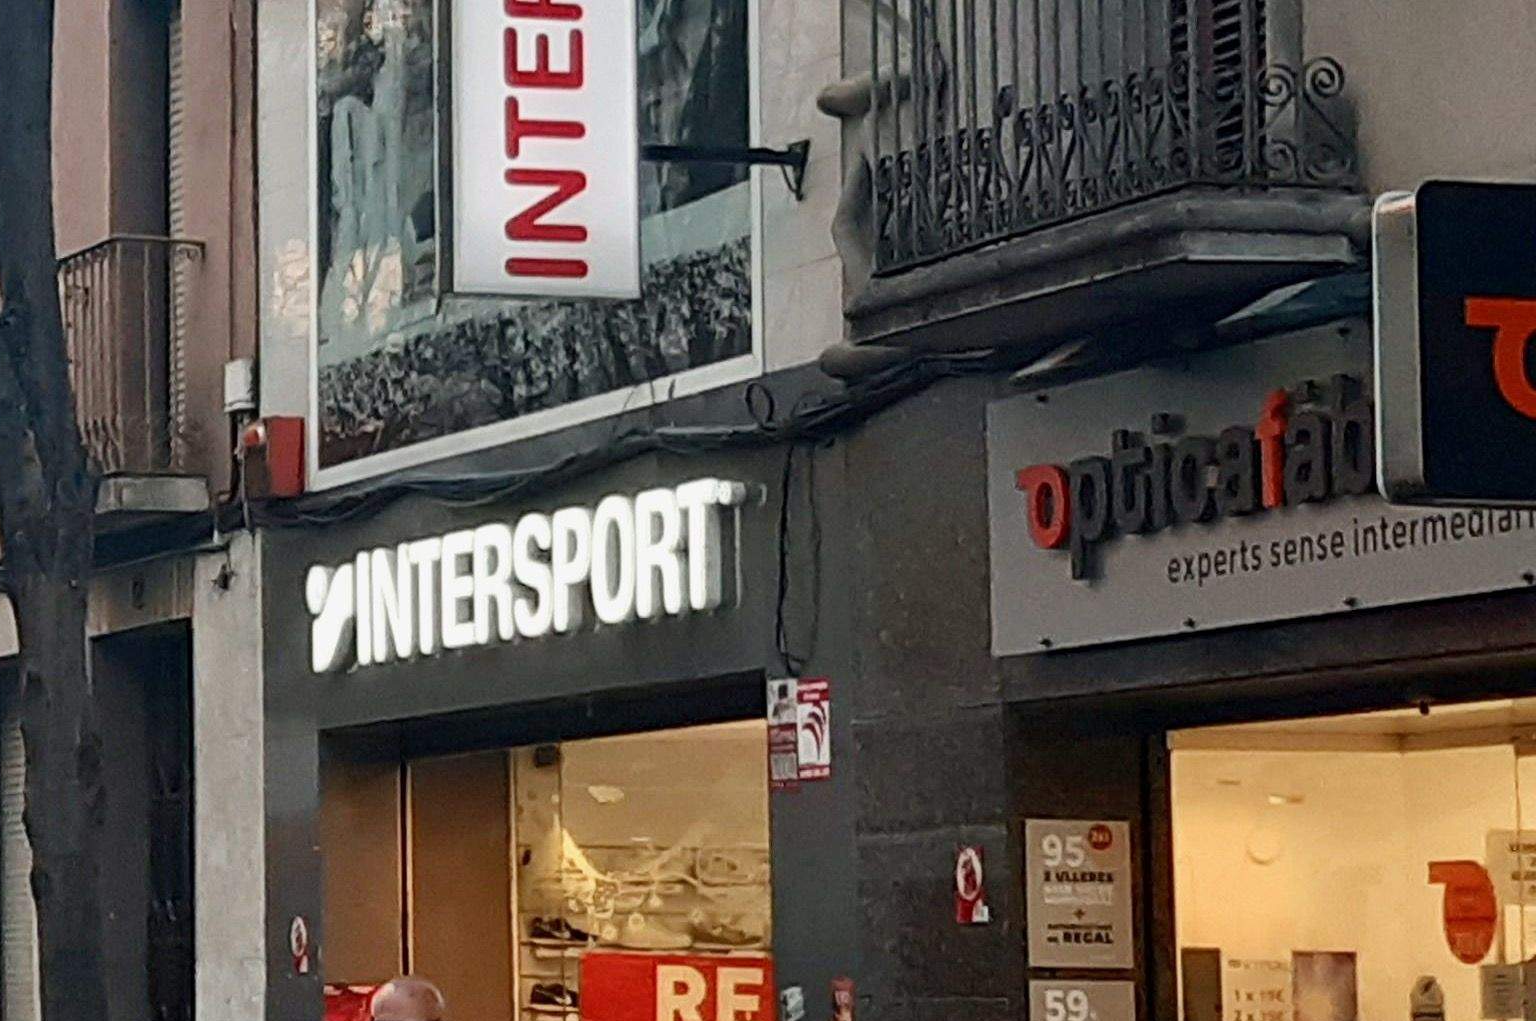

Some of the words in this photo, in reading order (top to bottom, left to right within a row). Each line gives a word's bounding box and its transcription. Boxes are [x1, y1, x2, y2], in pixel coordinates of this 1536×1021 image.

[356, 477, 725, 667] INTERSPORT
[1167, 539, 1262, 588] experts
[1270, 530, 1345, 568] sense
[1063, 931, 1114, 944] REGAL
